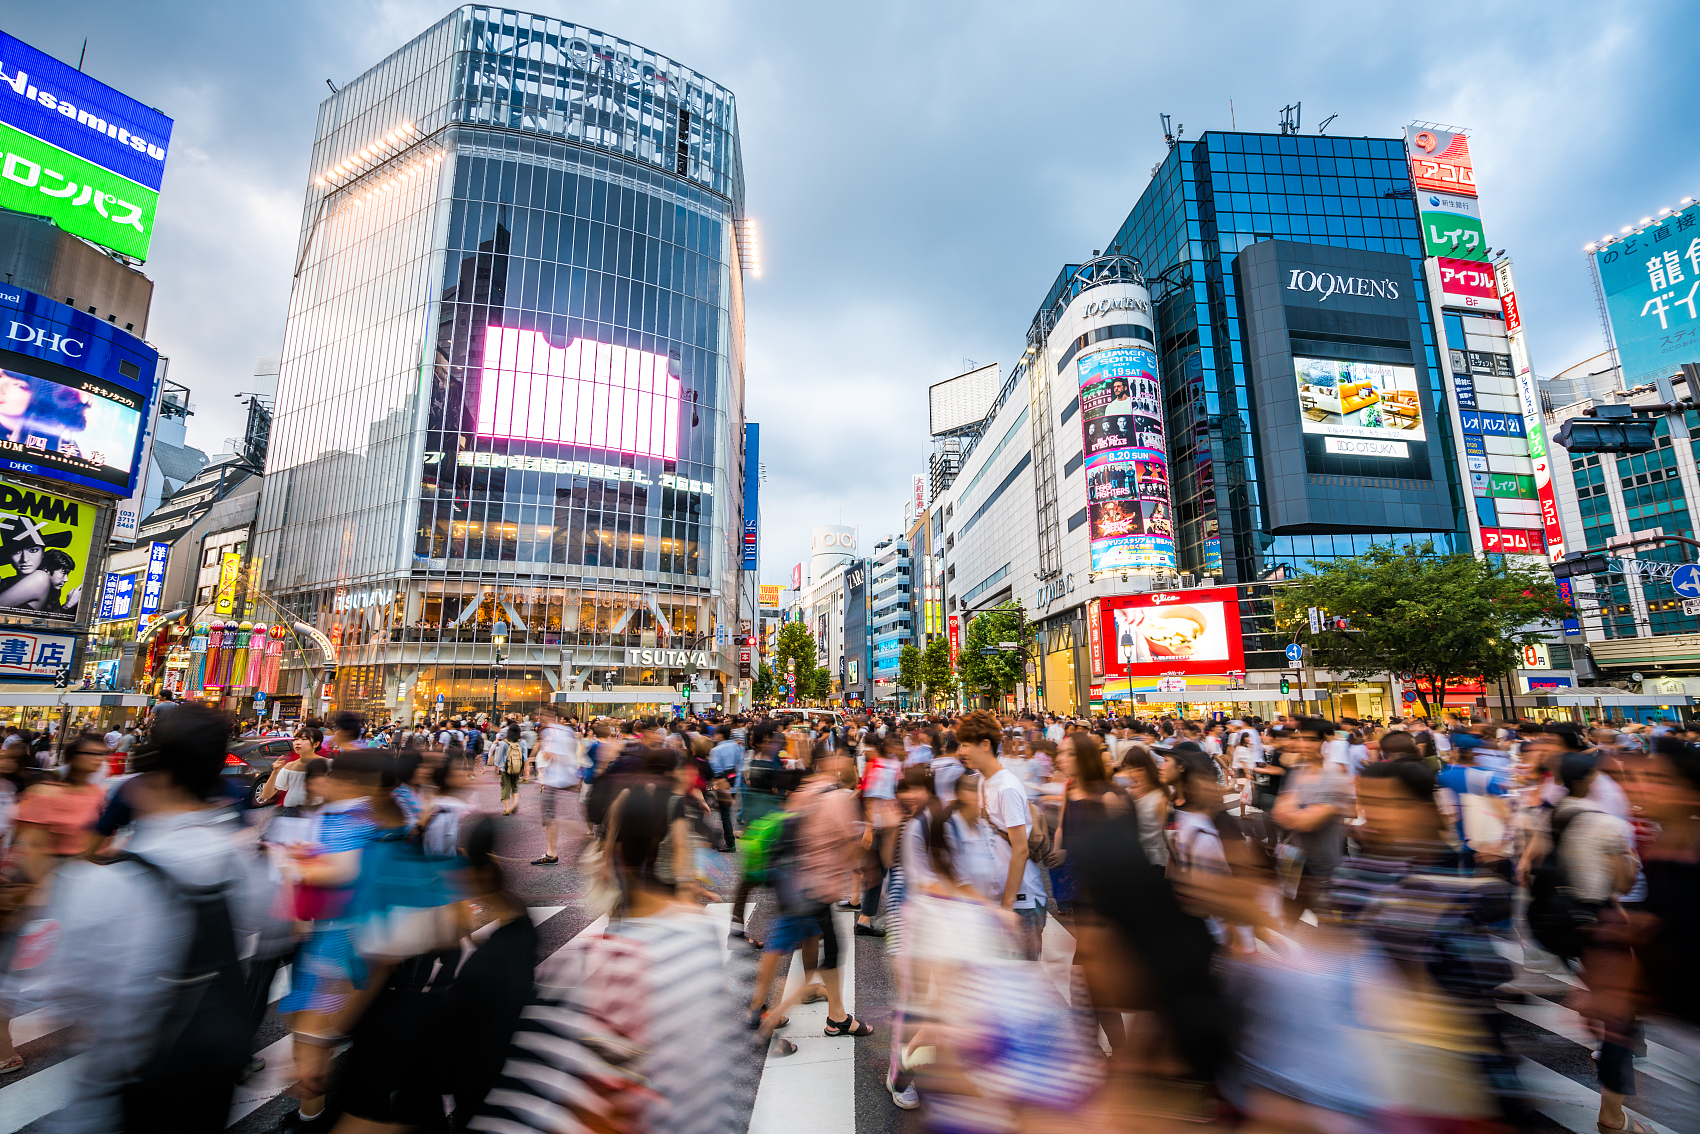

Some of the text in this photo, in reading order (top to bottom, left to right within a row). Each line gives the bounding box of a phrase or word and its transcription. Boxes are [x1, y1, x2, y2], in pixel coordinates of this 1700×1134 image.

[1421, 161, 1475, 185] アコム
[0, 152, 144, 233] ロンパス
[1441, 199, 1469, 210] 新生銀行
[1430, 224, 1479, 248] レイク
[1603, 212, 1697, 264] のど、直接
[1286, 269, 1399, 303] 109MEN'S
[1440, 267, 1494, 288] アイフル
[1082, 297, 1148, 319] 109MEN'S
[1465, 297, 1479, 306] 8F
[1506, 301, 1519, 329] アイフル
[6, 320, 84, 358] DHC
[1093, 350, 1146, 362] SUMMER
[1100, 356, 1141, 366] SONIC
[1103, 367, 1140, 378] 8.19 SAT
[1082, 388, 1112, 402] CALVIN
[1083, 396, 1112, 410] HARRIS
[1463, 416, 1520, 432] レオパレス21
[1356, 443, 1398, 455] OTSUKA
[1530, 431, 1541, 455] レイク
[9, 461, 33, 472] DHC
[1108, 450, 1149, 462] 8.20 SUN
[915, 477, 924, 509] 大和証券
[1493, 480, 1517, 491] レイク
[0, 484, 79, 527] DMM
[119, 509, 135, 518] (03)
[1542, 499, 1558, 525] アコム
[0, 512, 49, 546] FX
[116, 522, 134, 530] 2468
[745, 519, 757, 560] SEIBU
[1485, 533, 1528, 548] アコム
[143, 545, 167, 609] 洋服の青山
[337, 588, 393, 610] TSUTAYA
[483, 591, 648, 610] STARBUCKS COFFEE
[1152, 593, 1180, 605] Glico
[1560, 582, 1574, 617] PROM
[0, 638, 66, 668] 書店
[629, 649, 707, 667] TSUTAYA
